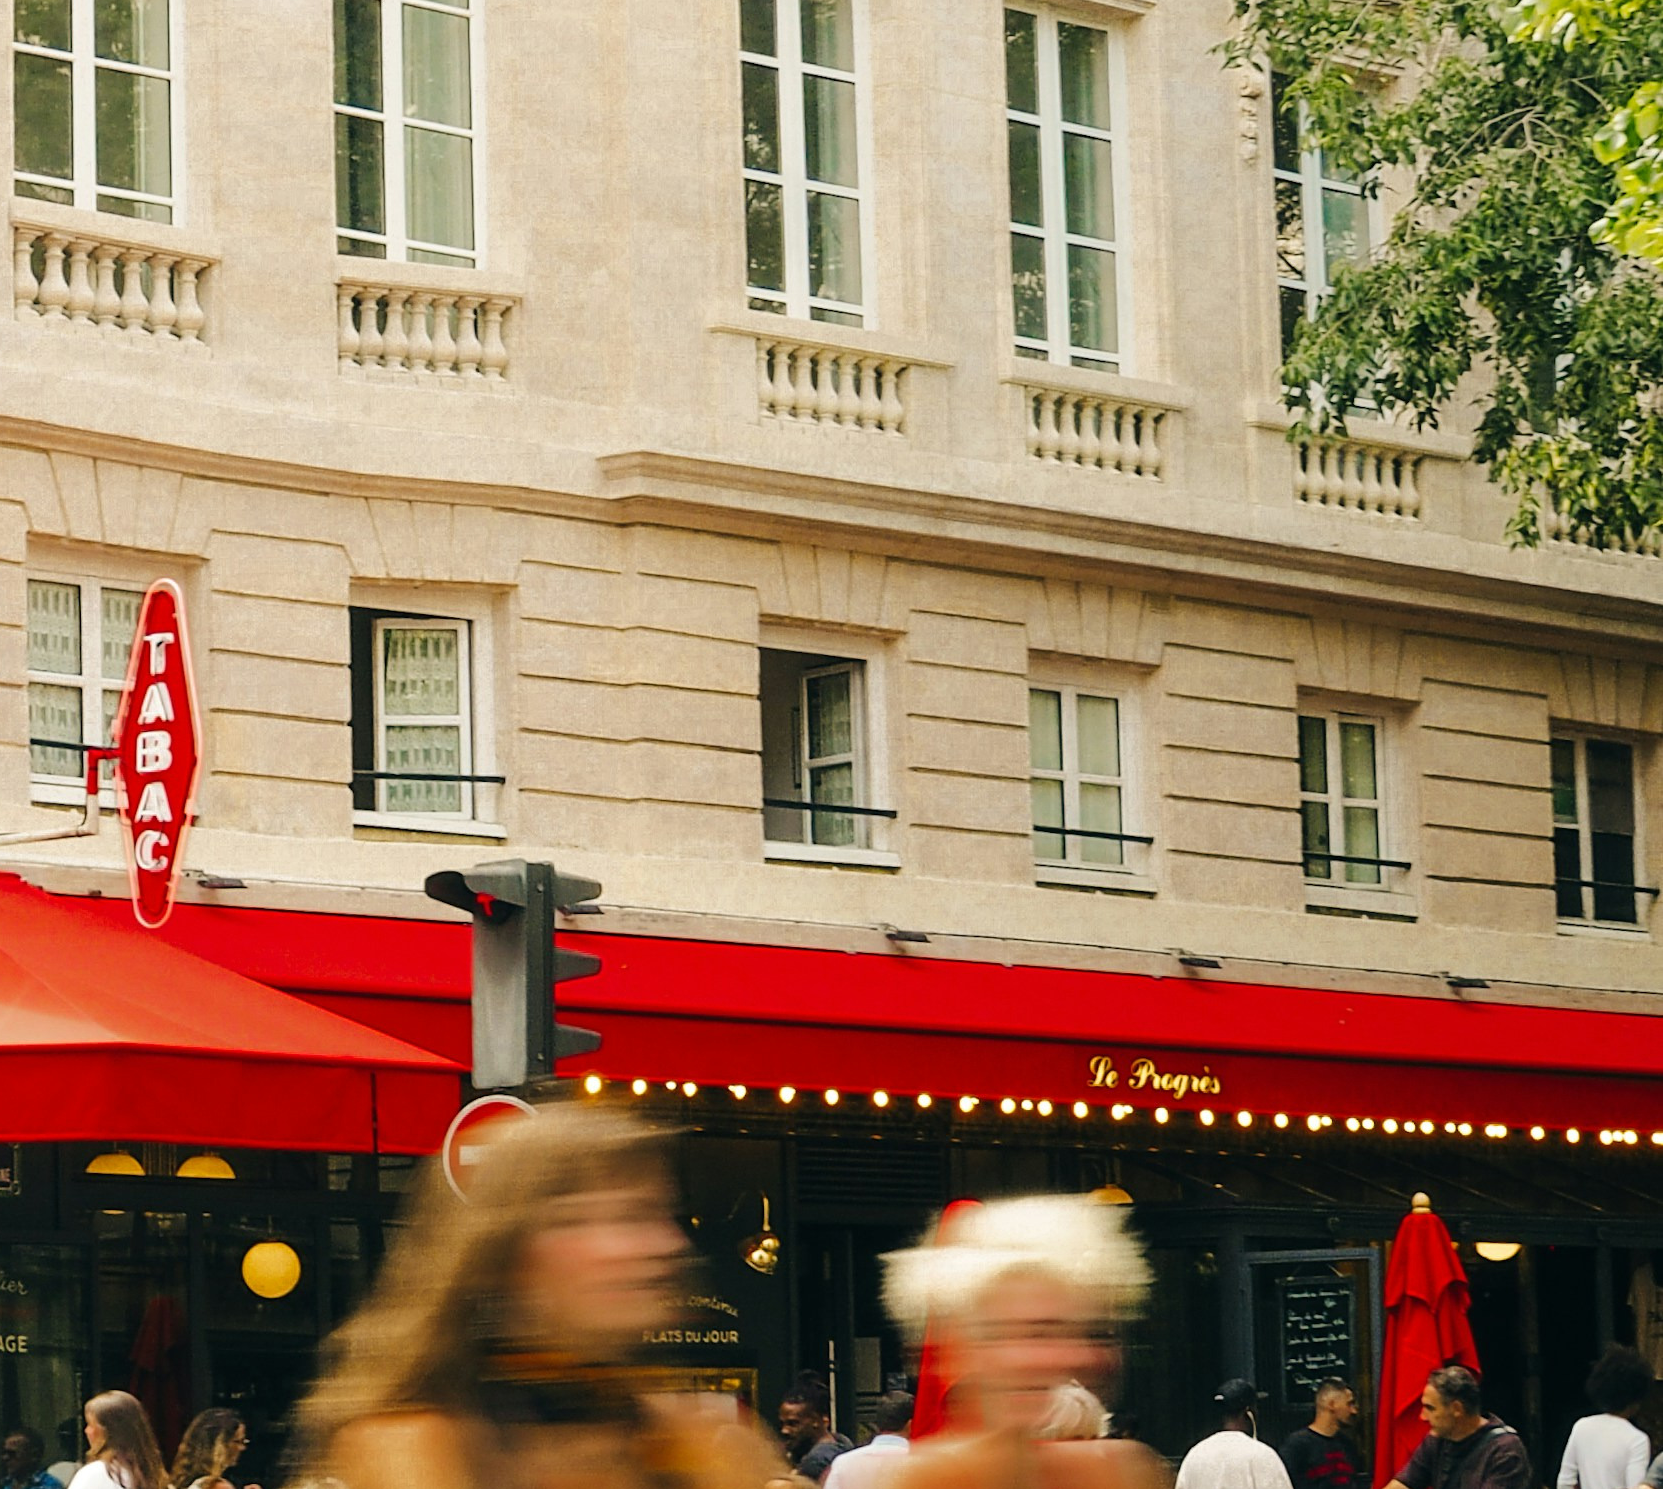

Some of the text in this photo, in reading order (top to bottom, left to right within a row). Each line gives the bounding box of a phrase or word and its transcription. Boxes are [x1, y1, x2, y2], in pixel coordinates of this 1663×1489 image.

[134, 632, 175, 872] TABAC
[1087, 1055, 1221, 1100] Le Progrès
[642, 1329, 739, 1343] PLATS DU JOUR
